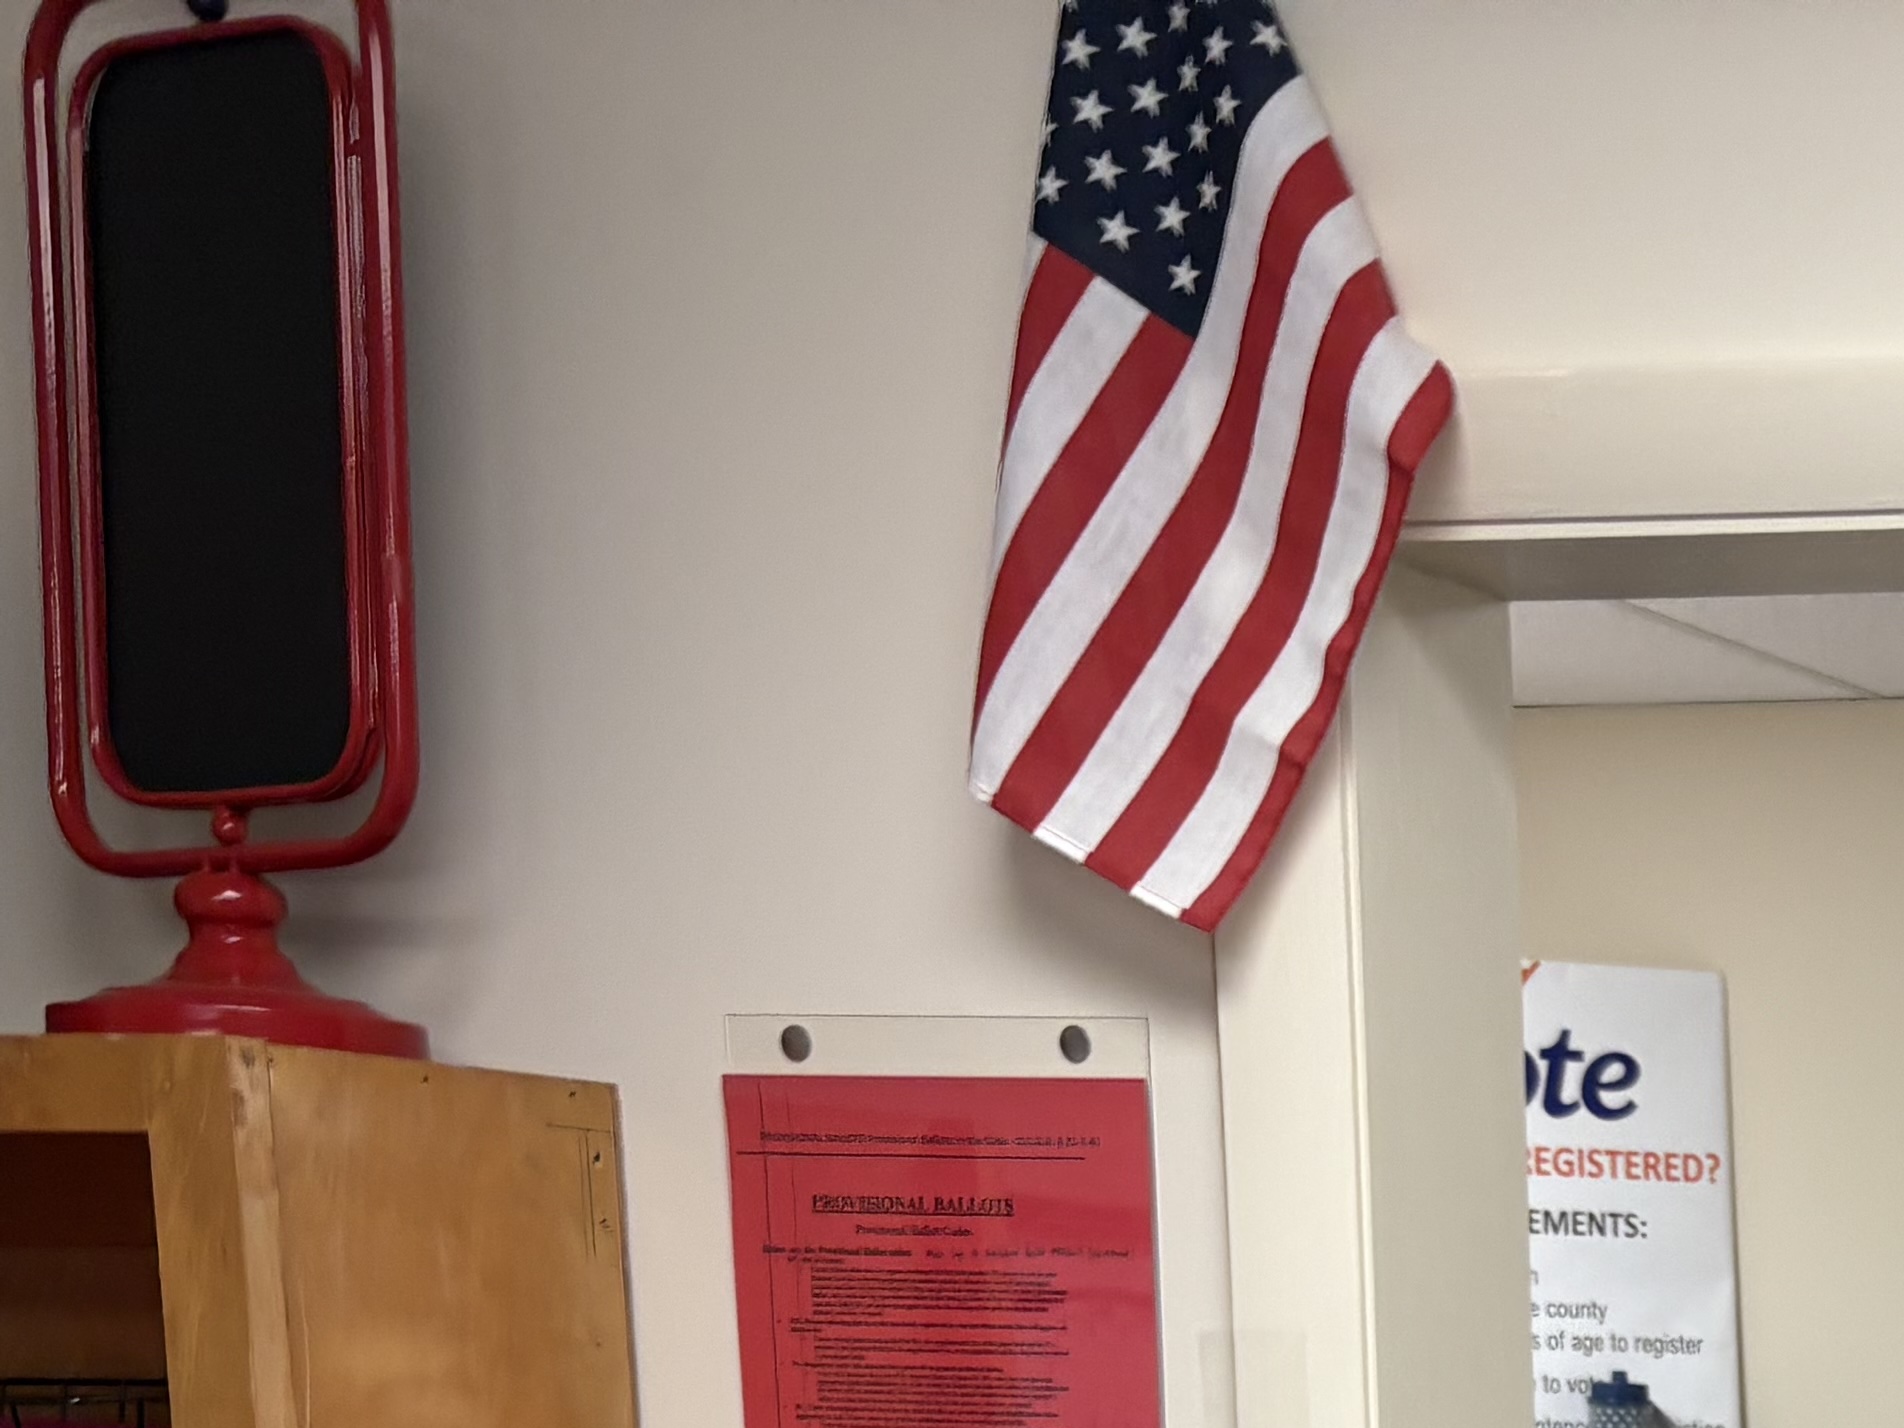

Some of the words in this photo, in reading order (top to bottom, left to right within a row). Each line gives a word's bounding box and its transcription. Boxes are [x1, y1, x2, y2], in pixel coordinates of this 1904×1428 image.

[1546, 1300, 1607, 1325] county
[1547, 1330, 1565, 1350] of
[1571, 1335, 1604, 1357] age
[1610, 1332, 1628, 1353] to
[1635, 1332, 1704, 1359] register
[1543, 1375, 1562, 1394] to
